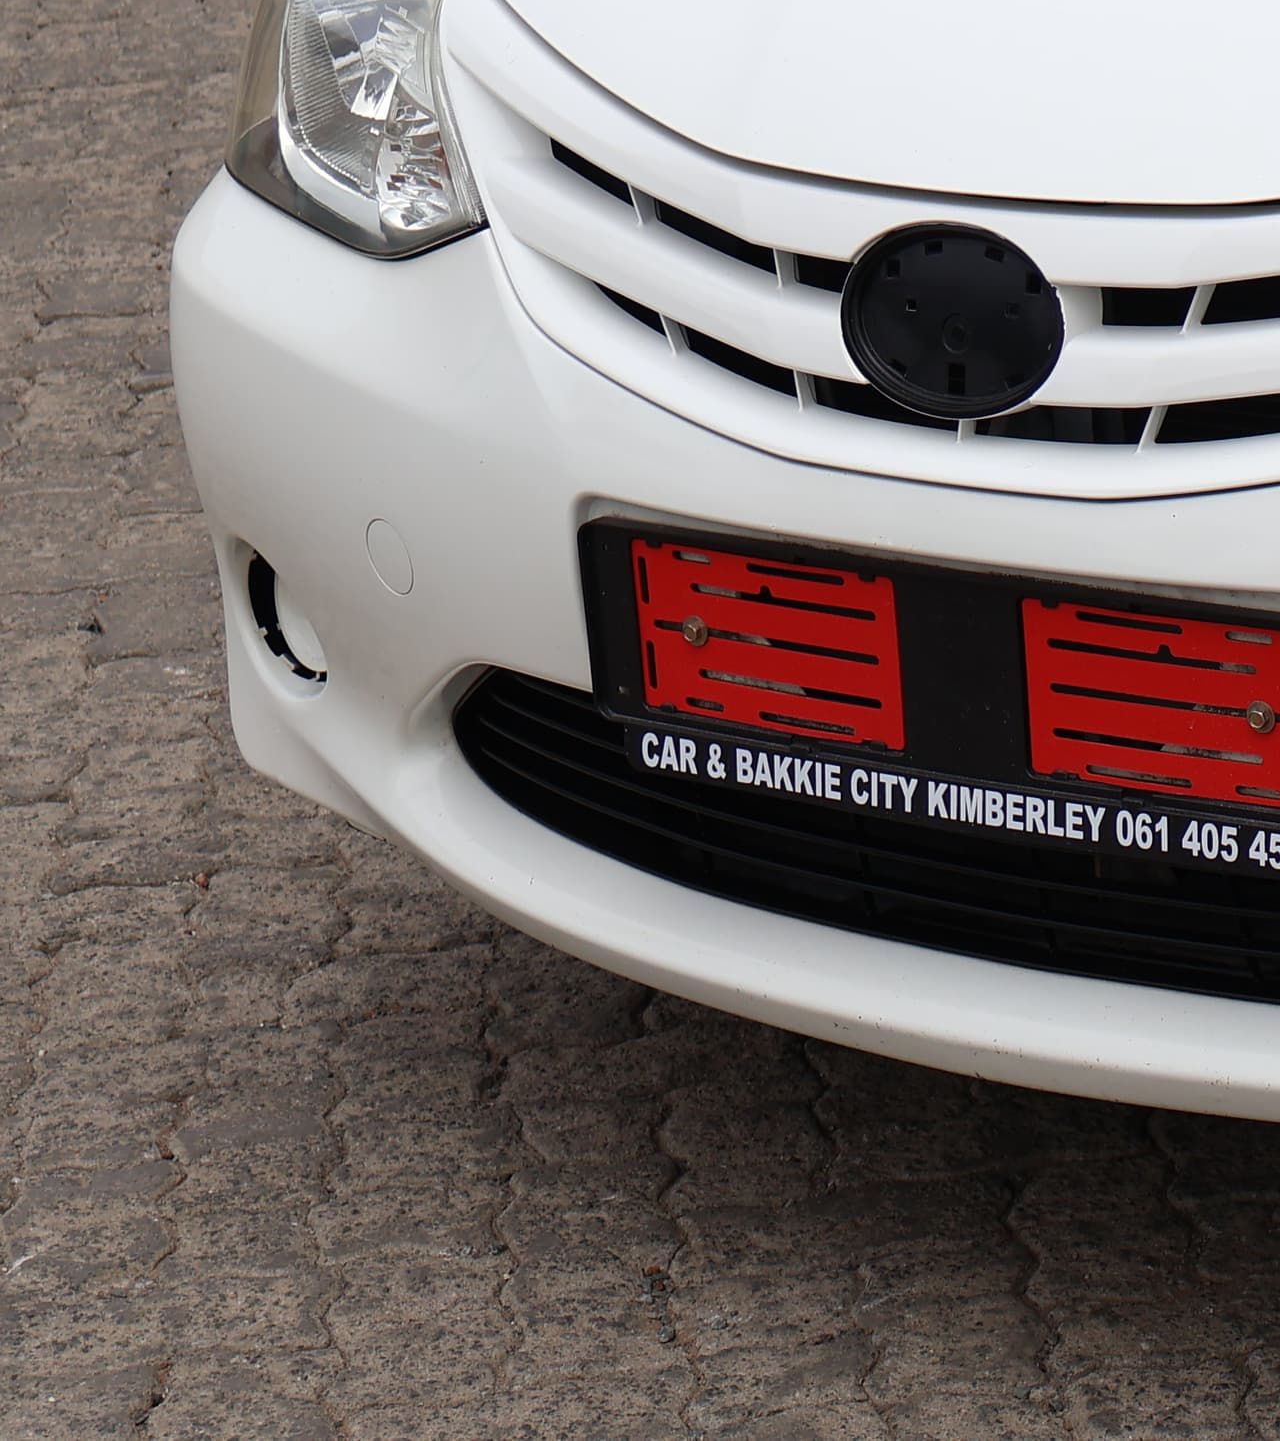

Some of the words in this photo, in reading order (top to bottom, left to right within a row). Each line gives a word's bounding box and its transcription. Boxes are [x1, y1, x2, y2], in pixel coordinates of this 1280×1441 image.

[641, 732, 698, 775] CAR
[706, 743, 727, 780] &
[735, 748, 842, 800] BAKKIE
[850, 768, 919, 813] CITY
[926, 781, 1106, 842] KIMBERLEY
[1115, 810, 1169, 852] 061
[1181, 820, 1239, 862] 405
